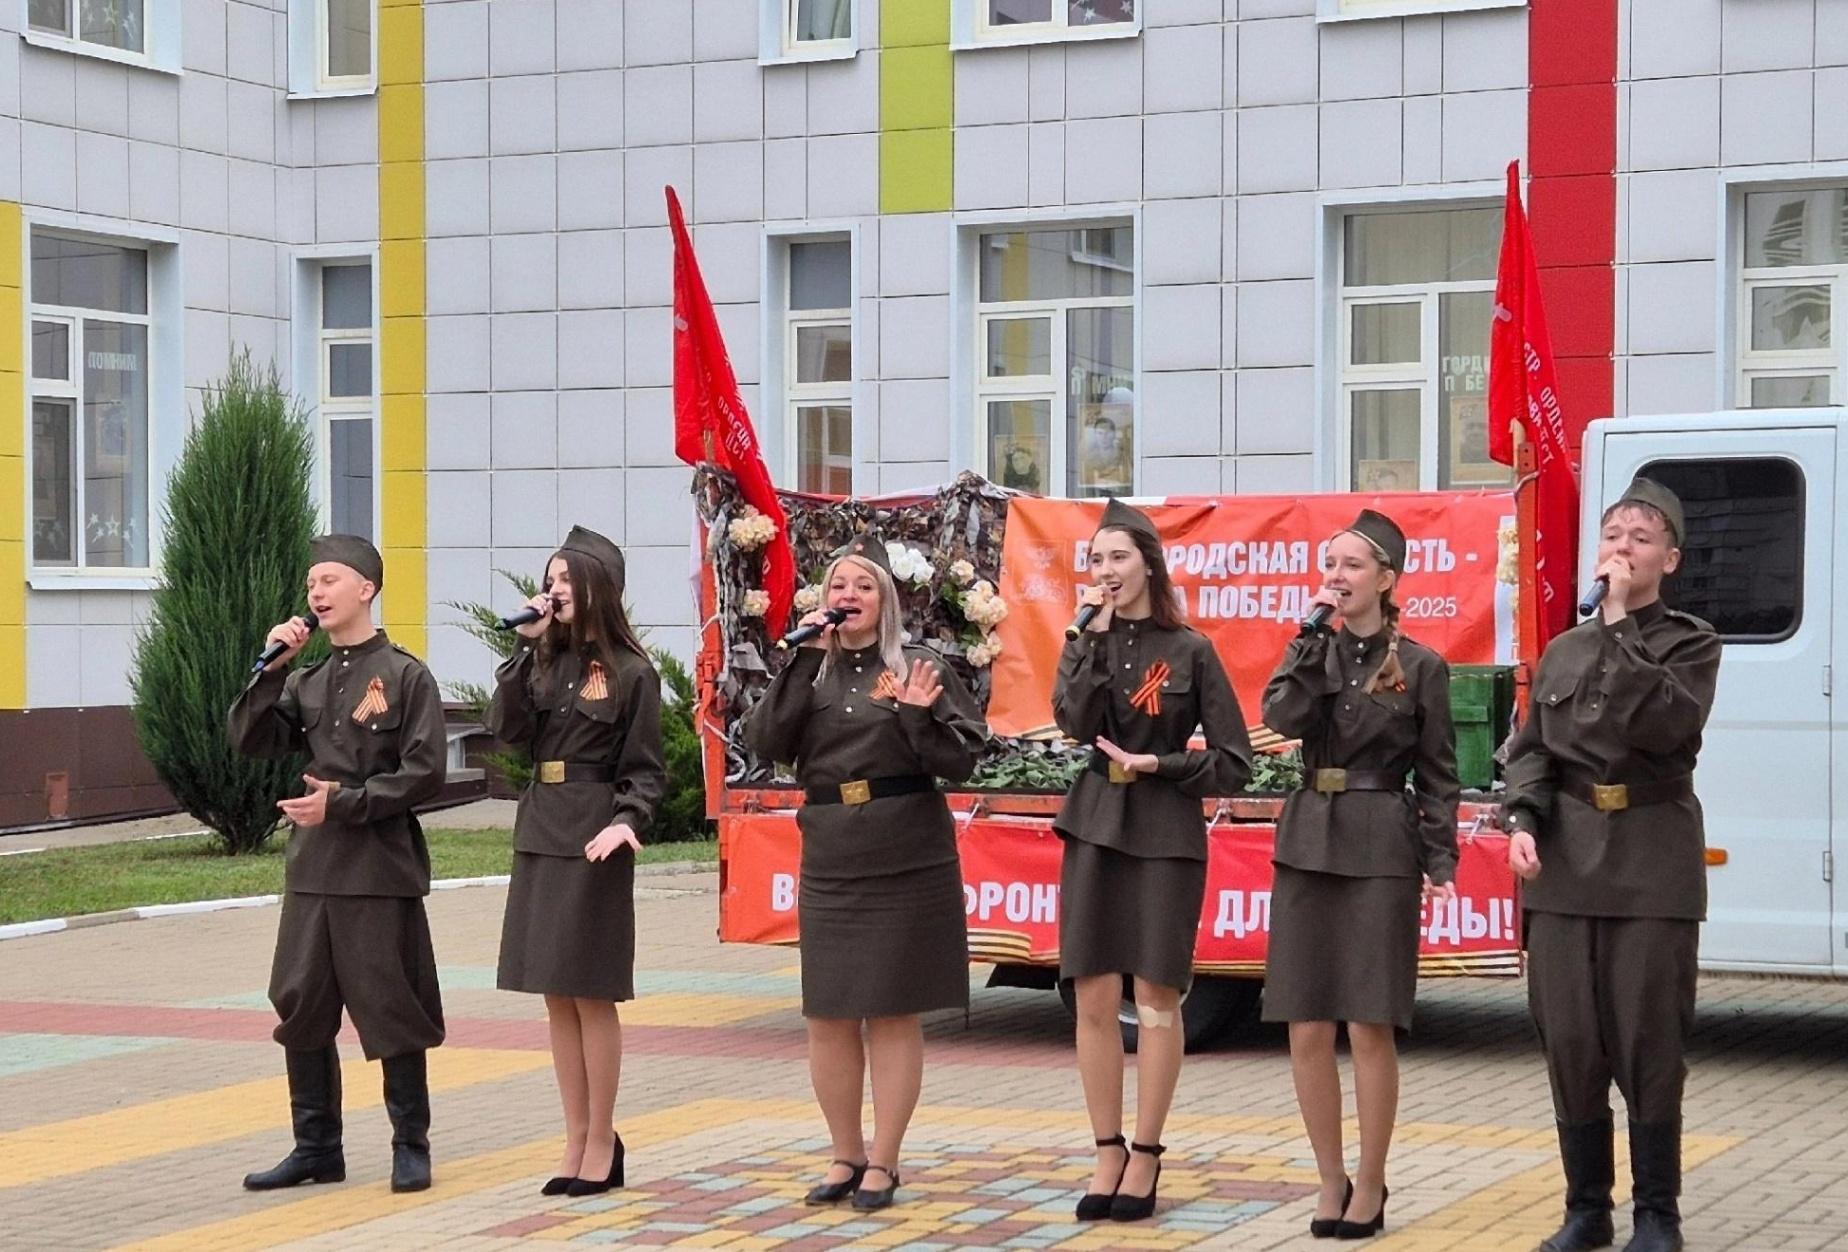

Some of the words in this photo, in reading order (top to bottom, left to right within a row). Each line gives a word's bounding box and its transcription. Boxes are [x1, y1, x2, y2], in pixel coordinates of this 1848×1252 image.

[1074, 540, 1309, 580] БРОДСКАЯ
[1317, 539, 1456, 574] ОСТЬ
[963, 881, 1061, 923] РОН
[1213, 889, 1273, 939] ДЛ
